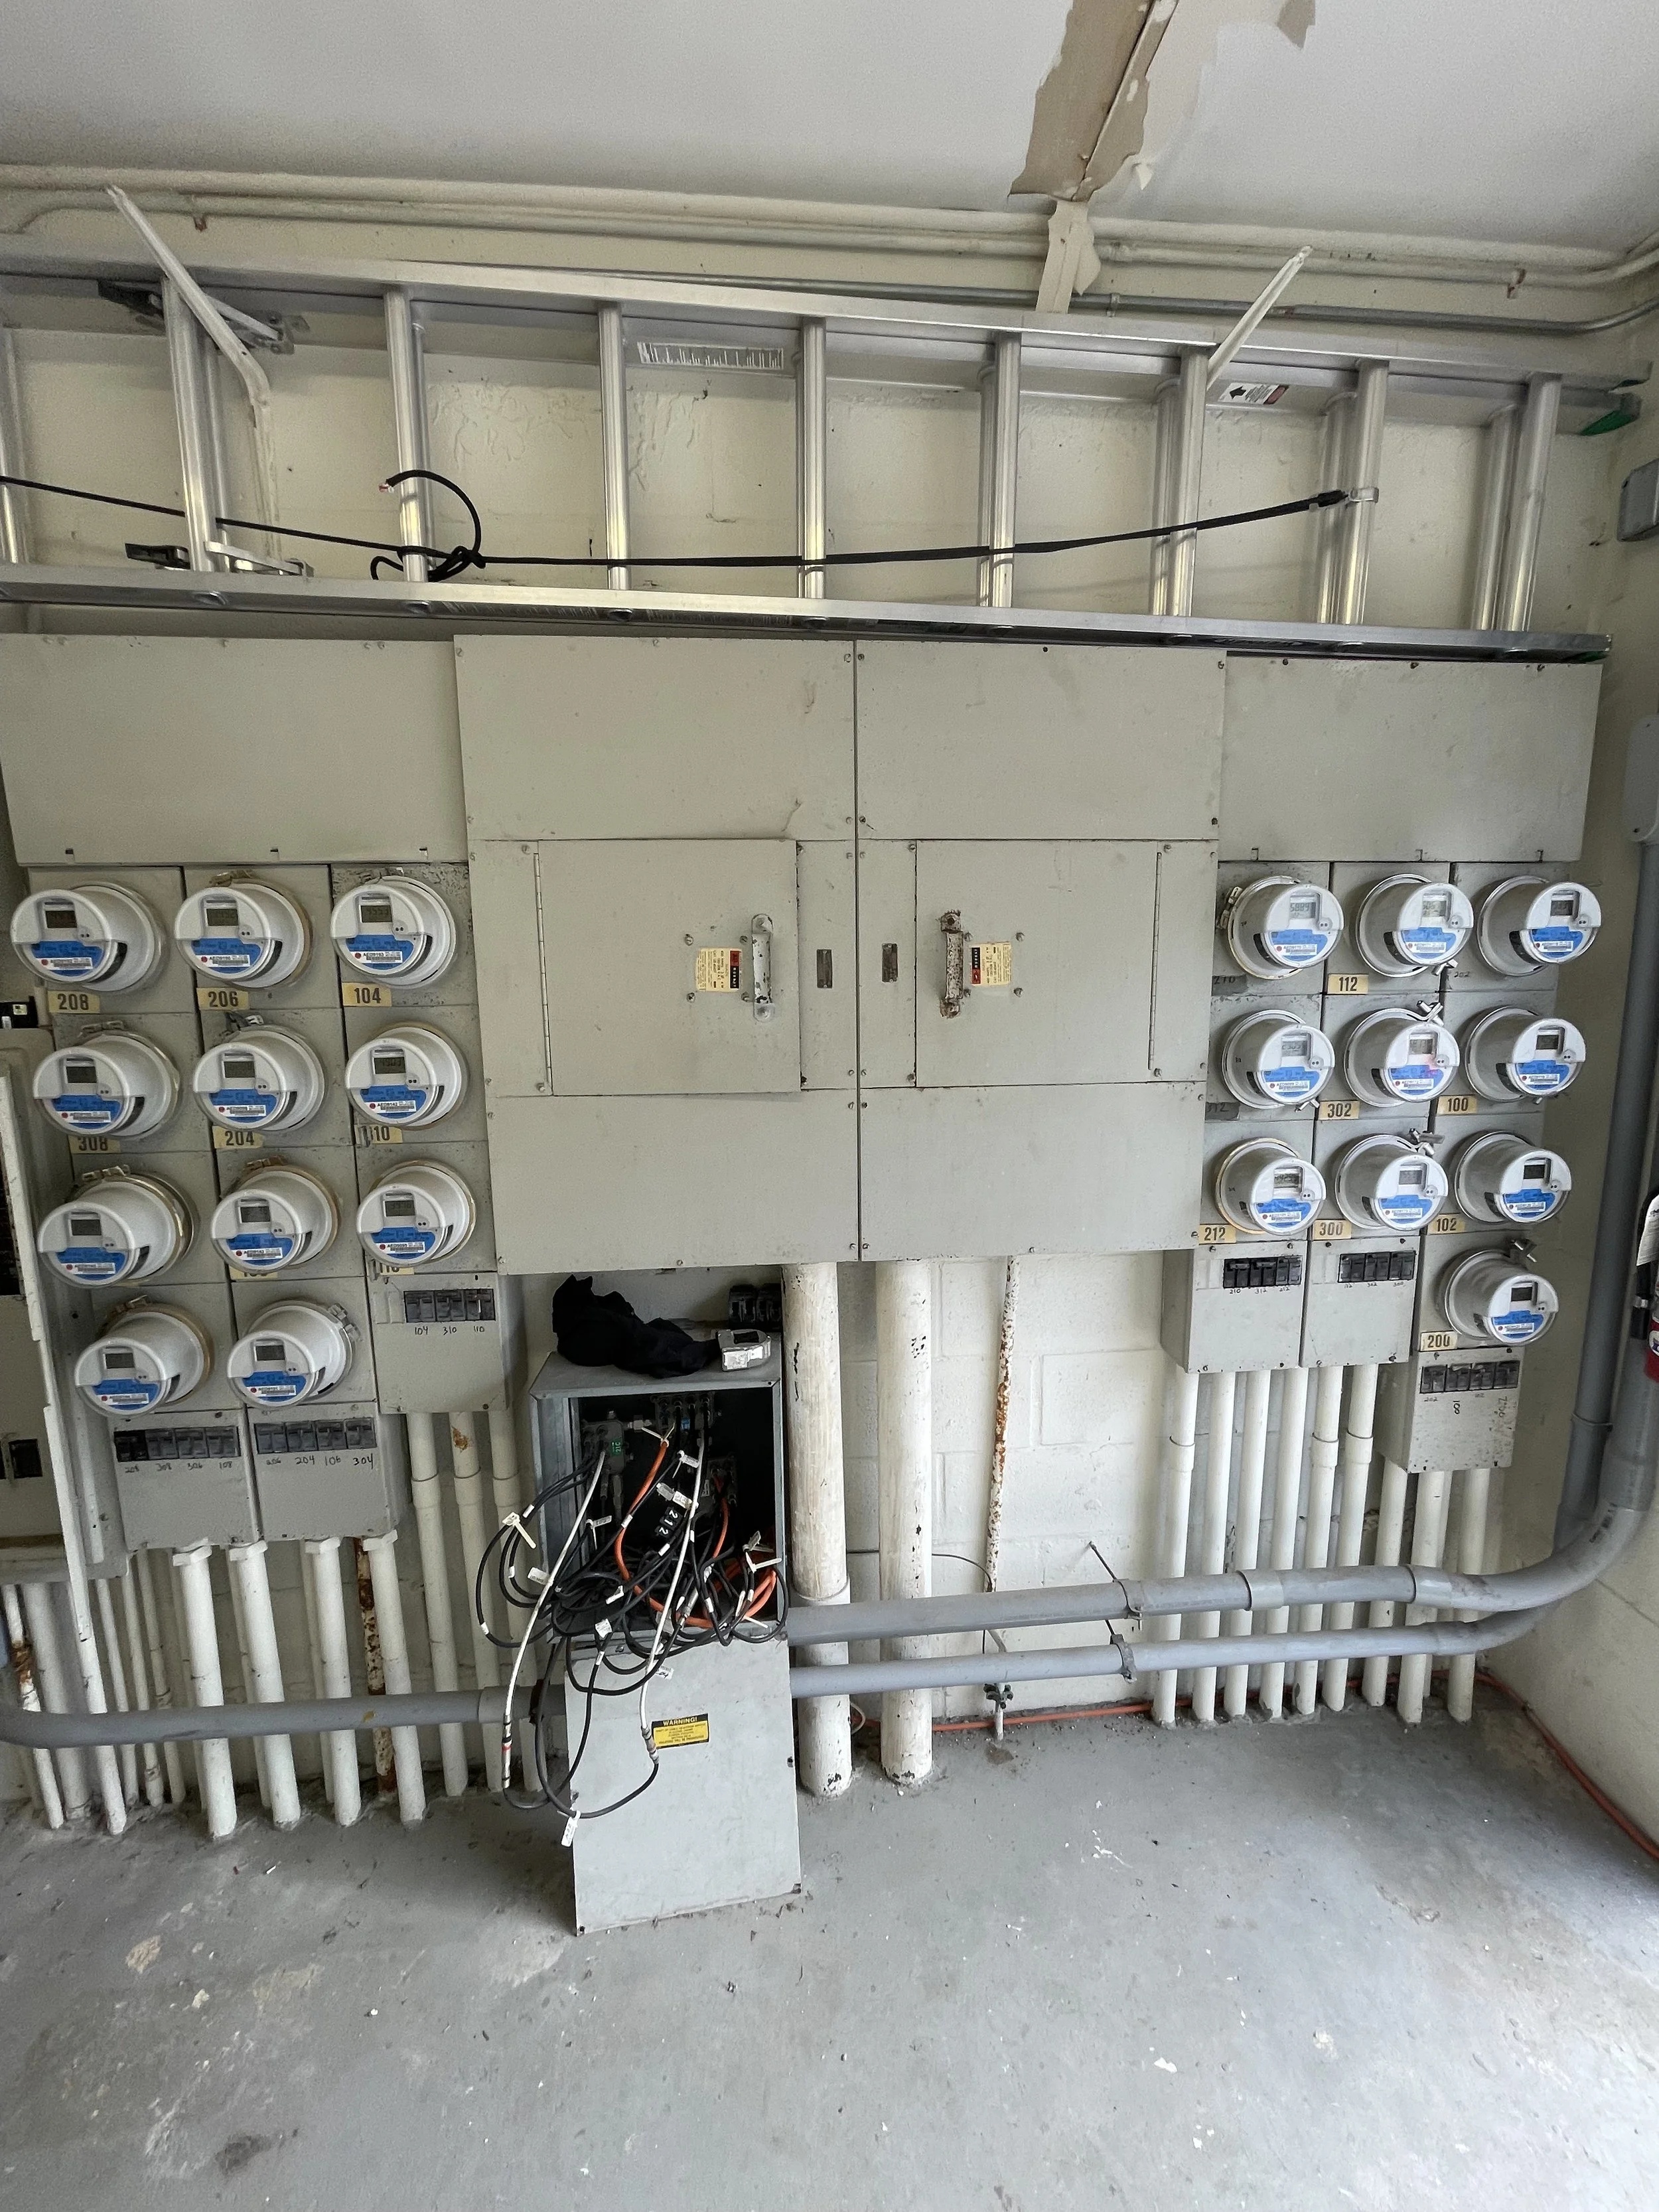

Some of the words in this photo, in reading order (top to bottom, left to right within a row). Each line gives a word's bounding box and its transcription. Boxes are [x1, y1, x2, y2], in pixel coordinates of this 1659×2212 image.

[1338, 976, 1358, 992] 112
[58, 994, 89, 1010] 208
[208, 991, 238, 1007] 206
[354, 988, 381, 1003] 104
[1327, 1103, 1352, 1118] 302
[1447, 1097, 1469, 1112] 100
[78, 1136, 108, 1151] 308
[225, 1130, 254, 1145] 204
[1319, 1222, 1343, 1236] 300
[1437, 1217, 1457, 1232] 102
[1204, 1226, 1226, 1241] 212
[415, 1325, 428, 1335] 104
[443, 1326, 457, 1336] 310
[1427, 1334, 1450, 1348] 200
[295, 1455, 315, 1465] 204
[325, 1455, 341, 1466] 106
[353, 1453, 374, 1470] 304
[663, 1716, 697, 1726] WARNING!
